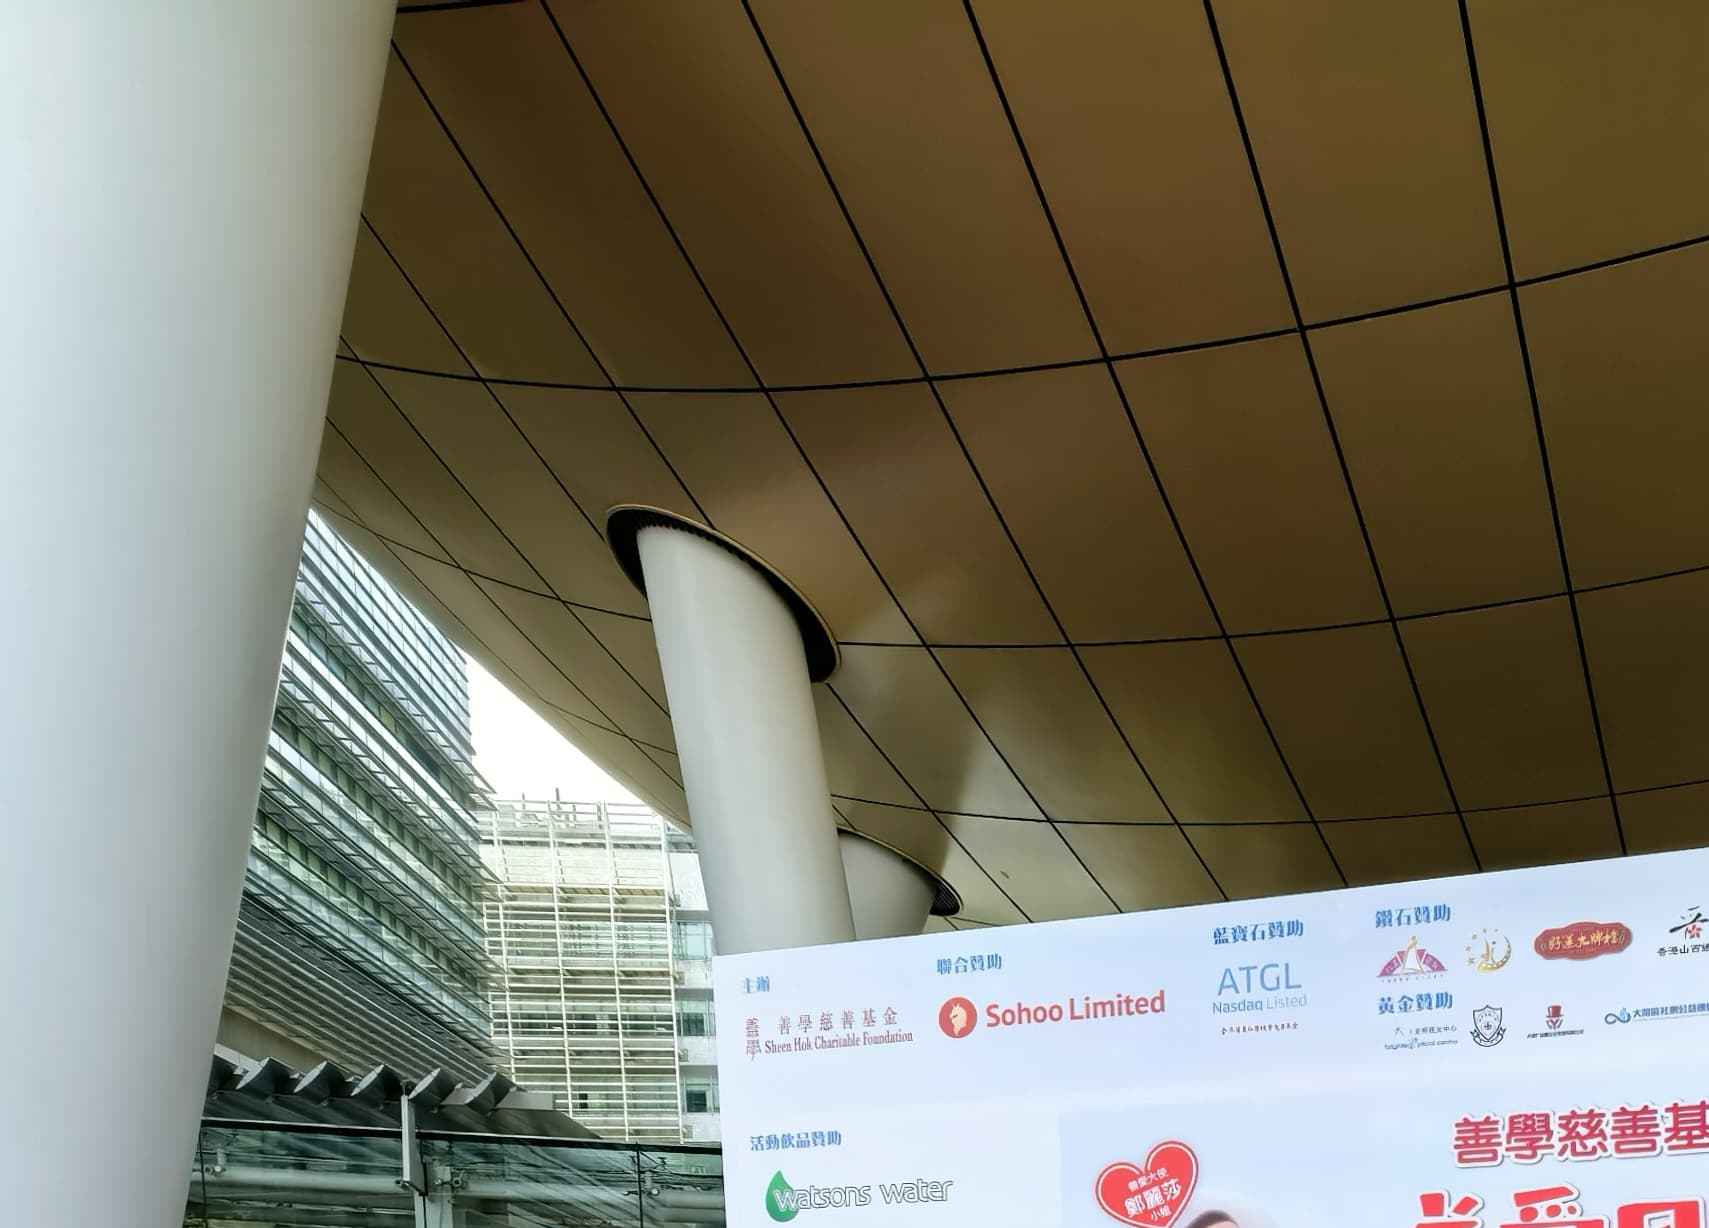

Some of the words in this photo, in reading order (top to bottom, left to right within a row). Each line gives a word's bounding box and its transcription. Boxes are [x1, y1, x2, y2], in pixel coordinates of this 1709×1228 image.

[1213, 919, 1304, 945] 藍寶石贊助
[936, 952, 1003, 976] 聯合贊助
[1217, 962, 1302, 996] ATGL
[986, 1001, 1063, 1028] Sohoo
[1069, 989, 1165, 1021] Limited
[1212, 999, 1263, 1015] Nasdaq
[1266, 994, 1307, 1010] Listed
[1377, 991, 1453, 1015] 黃金贊助
[778, 1006, 898, 1036] 善學慈善基金
[764, 1039, 791, 1055] Sheen
[793, 1037, 813, 1052] Hok
[814, 1033, 861, 1050] Charitable
[862, 1027, 914, 1046] Foundation
[750, 1129, 842, 1152] 活動飲品贊助
[772, 1184, 872, 1212] watsons
[879, 1178, 954, 1204] water
